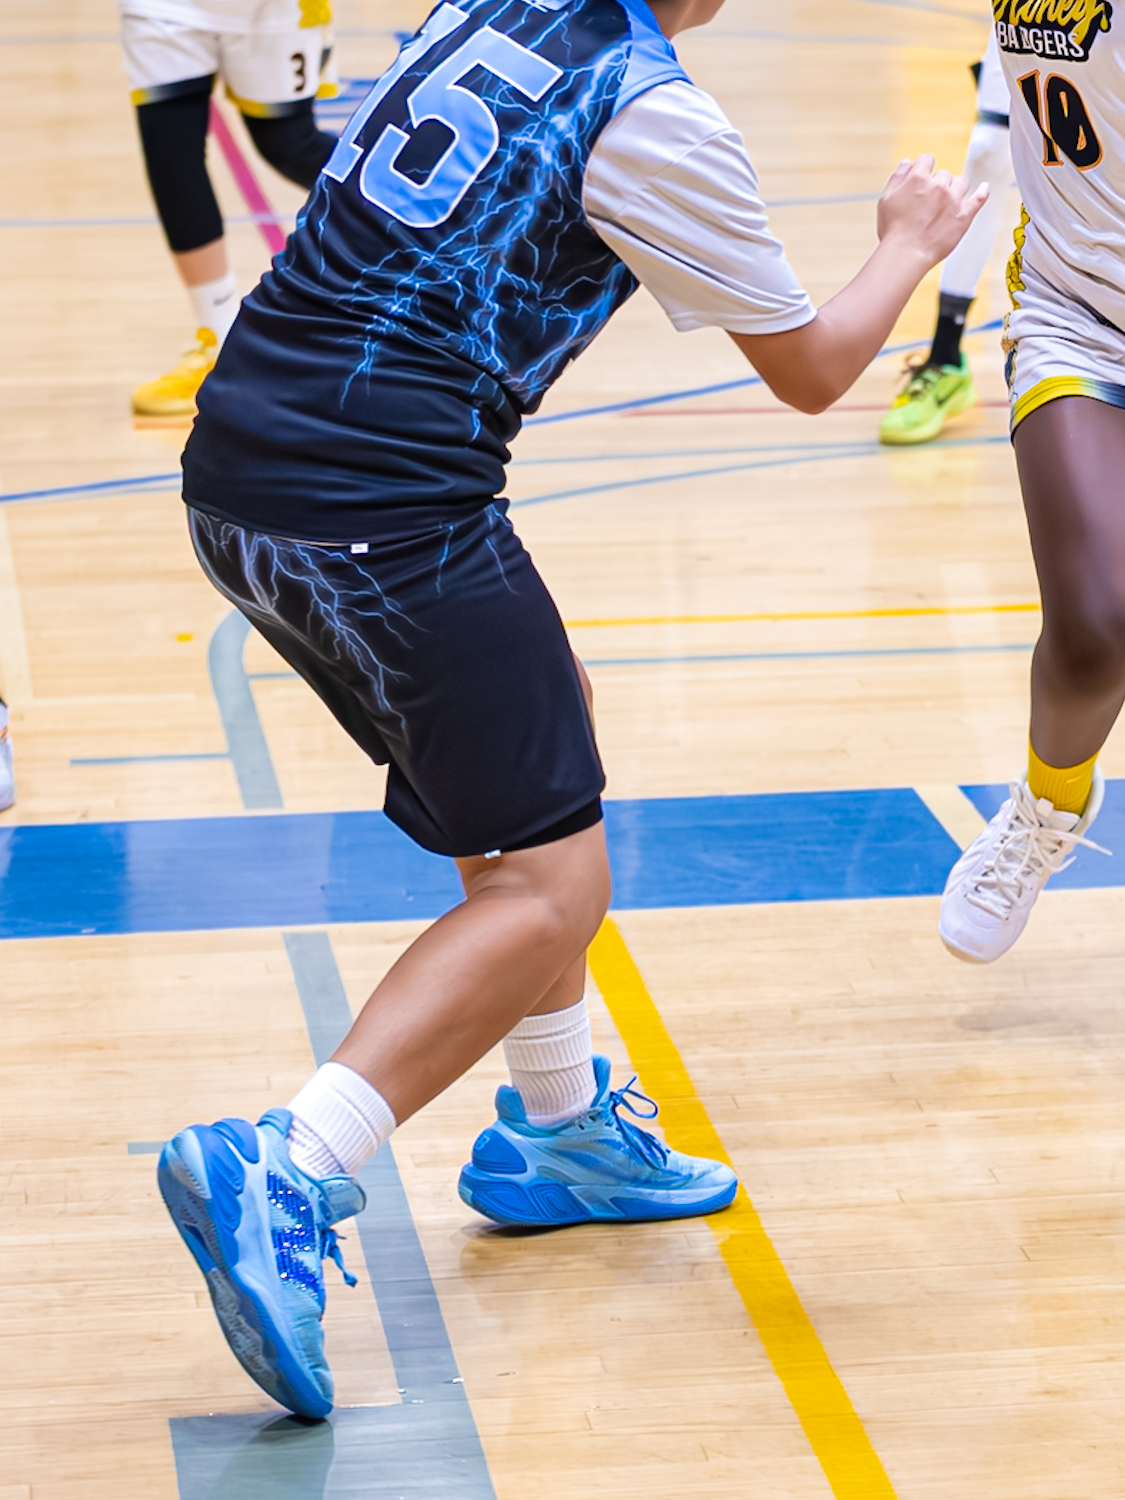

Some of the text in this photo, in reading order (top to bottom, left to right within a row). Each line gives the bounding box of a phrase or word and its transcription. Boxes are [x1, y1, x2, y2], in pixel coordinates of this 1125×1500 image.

[288, 51, 308, 94] 3
[997, 22, 1085, 58] BADGERS
[321, 2, 564, 229] 15
[1016, 69, 1104, 171] 10
